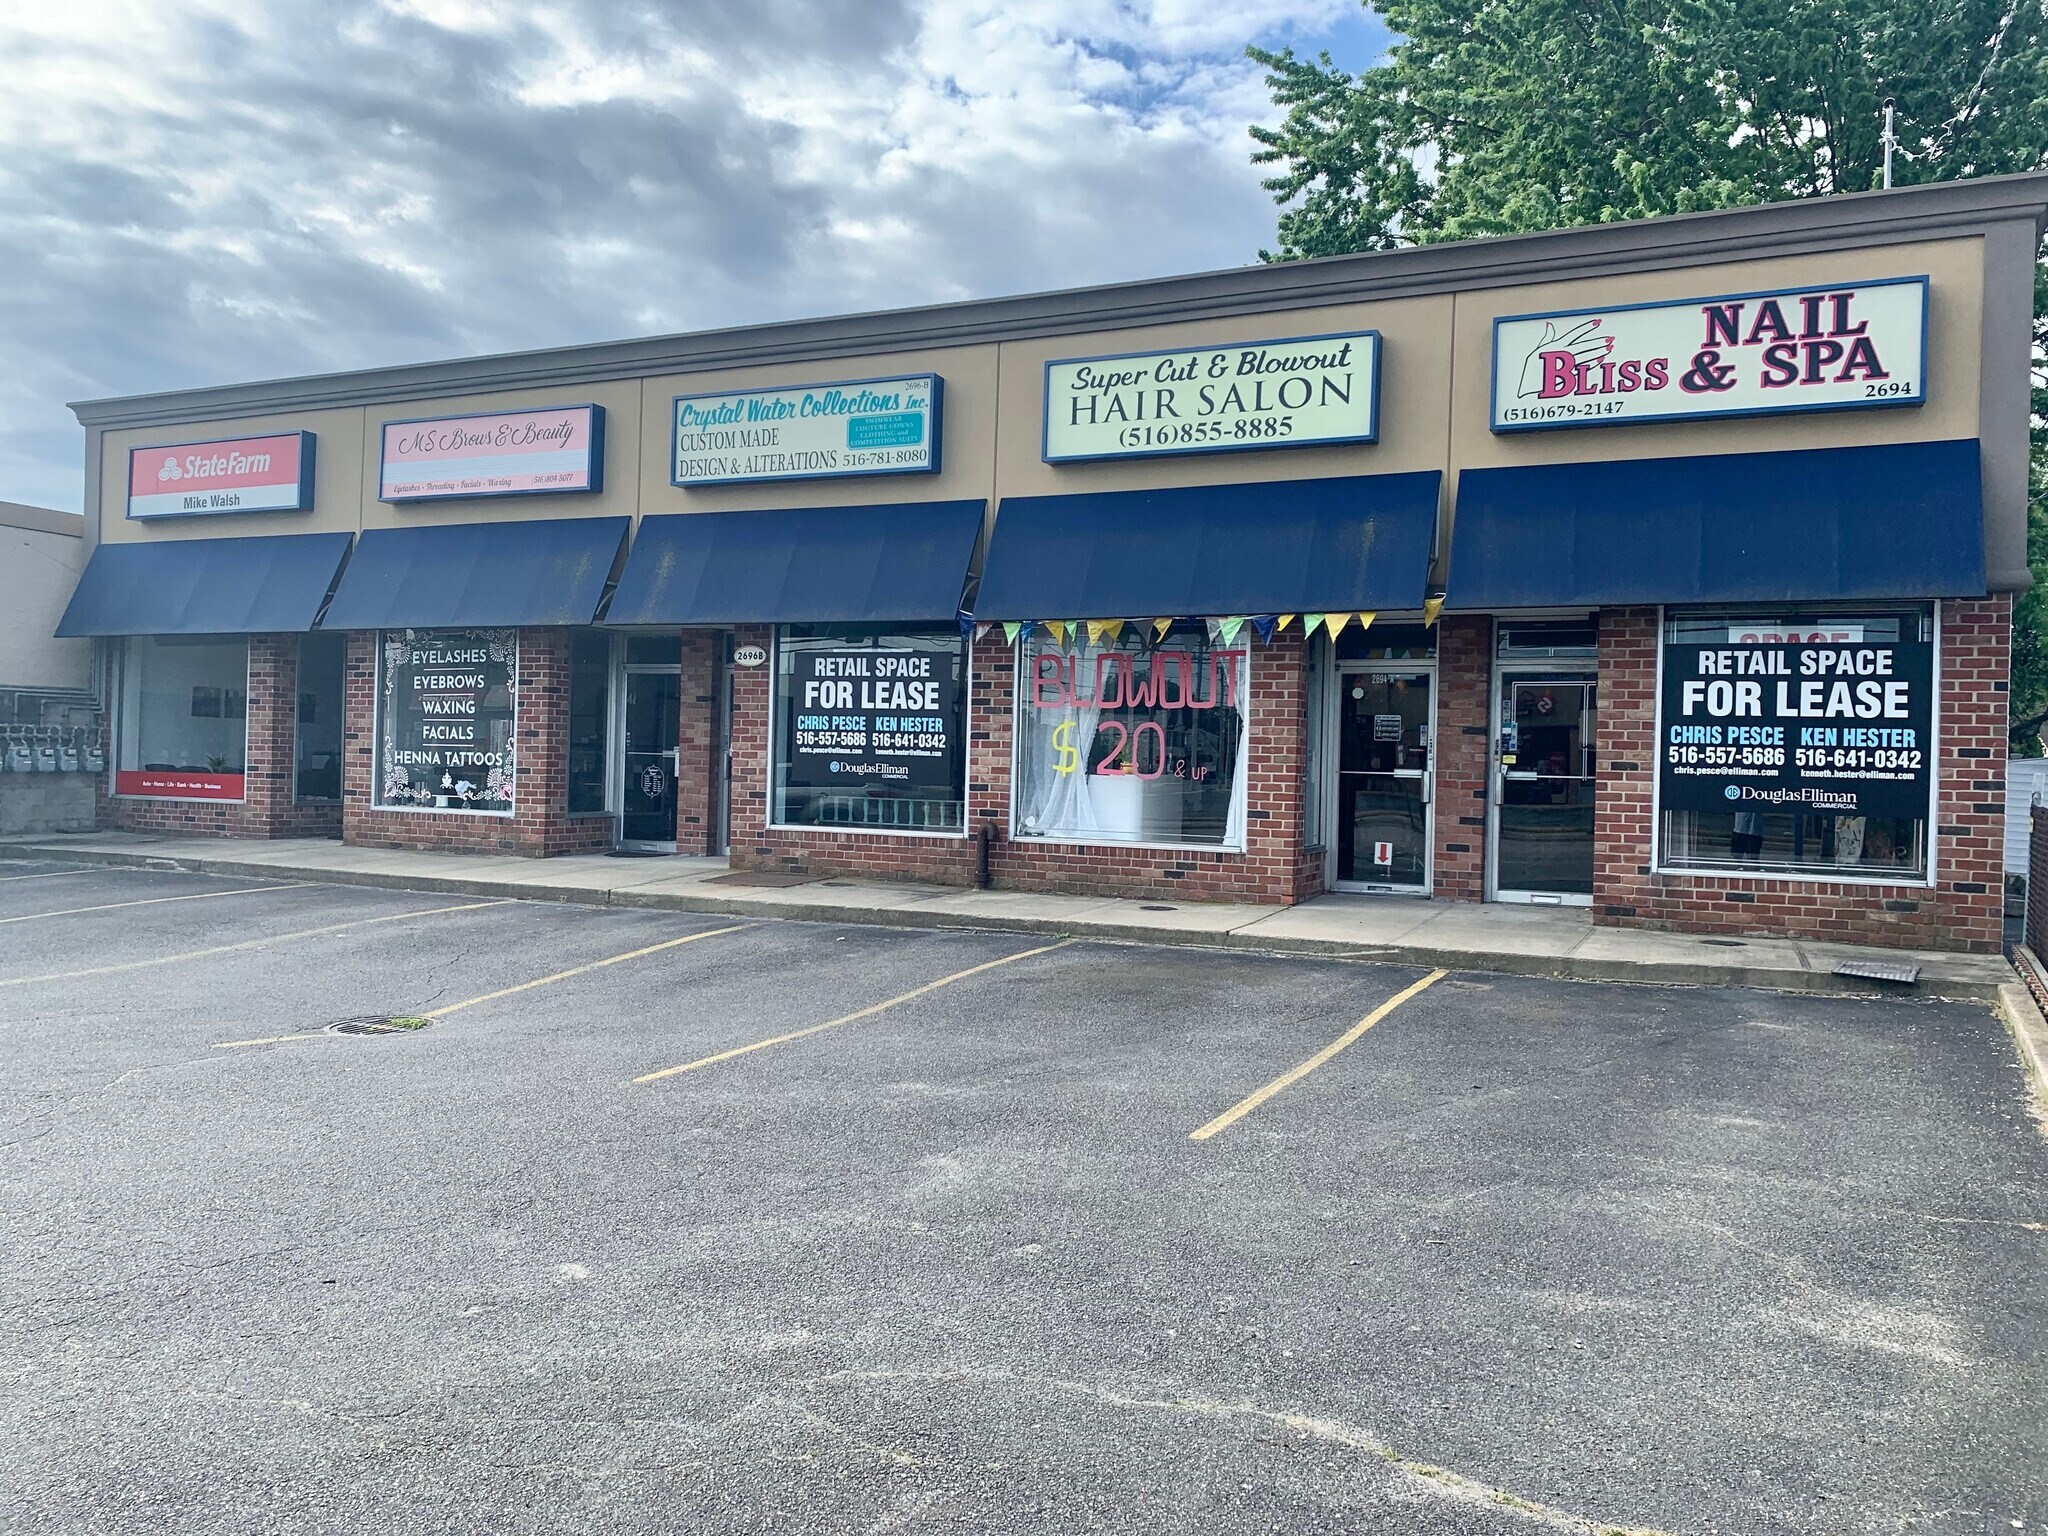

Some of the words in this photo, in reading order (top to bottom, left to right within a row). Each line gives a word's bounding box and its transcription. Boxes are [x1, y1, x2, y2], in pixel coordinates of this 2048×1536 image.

[1700, 292, 1869, 349] NAIL
[1070, 366, 1148, 396] Super
[1154, 356, 1199, 384] Cut
[1207, 354, 1230, 379] &
[1236, 342, 1352, 376] Blowout
[1679, 350, 1738, 394] &
[1760, 336, 1890, 389] SPA
[905, 381, 929, 391] 2696-B
[1865, 381, 1912, 398] 2694
[1069, 388, 1183, 426] HAIR
[1196, 372, 1354, 417] SALON
[680, 398, 745, 432] Crystal
[747, 397, 796, 423] Water
[799, 390, 900, 418] Collections
[904, 394, 929, 410] Inc.
[1503, 401, 1625, 422] (516)679-2147
[855, 423, 887, 432] COUTURE
[889, 422, 914, 430] GOWNS
[865, 416, 903, 424] SWIMWEAR
[398, 430, 437, 454] MS
[439, 427, 492, 451] Brows
[494, 424, 512, 447] &
[511, 419, 576, 448] Beauty
[680, 430, 736, 452] CUSTOM
[740, 427, 780, 447] MADE
[860, 430, 896, 438] CLOTHING
[1119, 415, 1293, 449] (516)855-8885
[850, 437, 897, 446] COMPETITION
[679, 457, 727, 477] DESIGN
[730, 458, 741, 475] &
[743, 450, 838, 473] ALTERATIONS
[843, 449, 927, 467] 516-781-8080
[393, 484, 421, 493] Eyelashes
[426, 482, 455, 492] Threading
[461, 480, 481, 488] Facials
[487, 478, 512, 488] Waxing
[183, 496, 208, 509] Mike
[210, 493, 240, 507] Walsh
[412, 649, 487, 664] EYELASHES
[737, 651, 764, 661] 2696B
[1698, 650, 1792, 675] RETAIL
[1799, 649, 1893, 676] SPACE
[814, 657, 871, 677] RETAIL
[875, 657, 930, 677] SPACE
[413, 674, 485, 689] EYEBROWS
[1032, 649, 1247, 709] BLOWOUT
[804, 680, 853, 709] FOR
[861, 681, 940, 710] LEASE
[1682, 680, 1762, 717] FOR
[1776, 680, 1909, 718] LEASE
[422, 700, 476, 714] WAXING
[797, 715, 829, 730] CHRIS
[832, 716, 866, 731] PESCE
[875, 717, 898, 732] KEN
[900, 717, 943, 732] HESTER
[422, 726, 474, 740] FACIALS
[796, 731, 867, 746] 516-557-5686
[872, 733, 946, 748] 516-641-0342
[1670, 725, 1722, 744] CHRIS
[1727, 726, 1784, 746] PESCE
[1800, 727, 1837, 747] KEN
[1843, 728, 1916, 748] HESTER
[394, 750, 441, 765] HENNA
[444, 751, 503, 766] TATTOOS
[1668, 746, 1785, 766] 516-557-5686
[1795, 748, 1922, 769] 516-641-0342
[1174, 759, 1186, 778] &
[1191, 766, 1208, 781] UP
[1673, 766, 1779, 777] chris.pesce@elliman.com
[1800, 768, 1915, 781] kenneth.hester@elliman.com
[1812, 802, 1858, 810] COMMERCIAL
